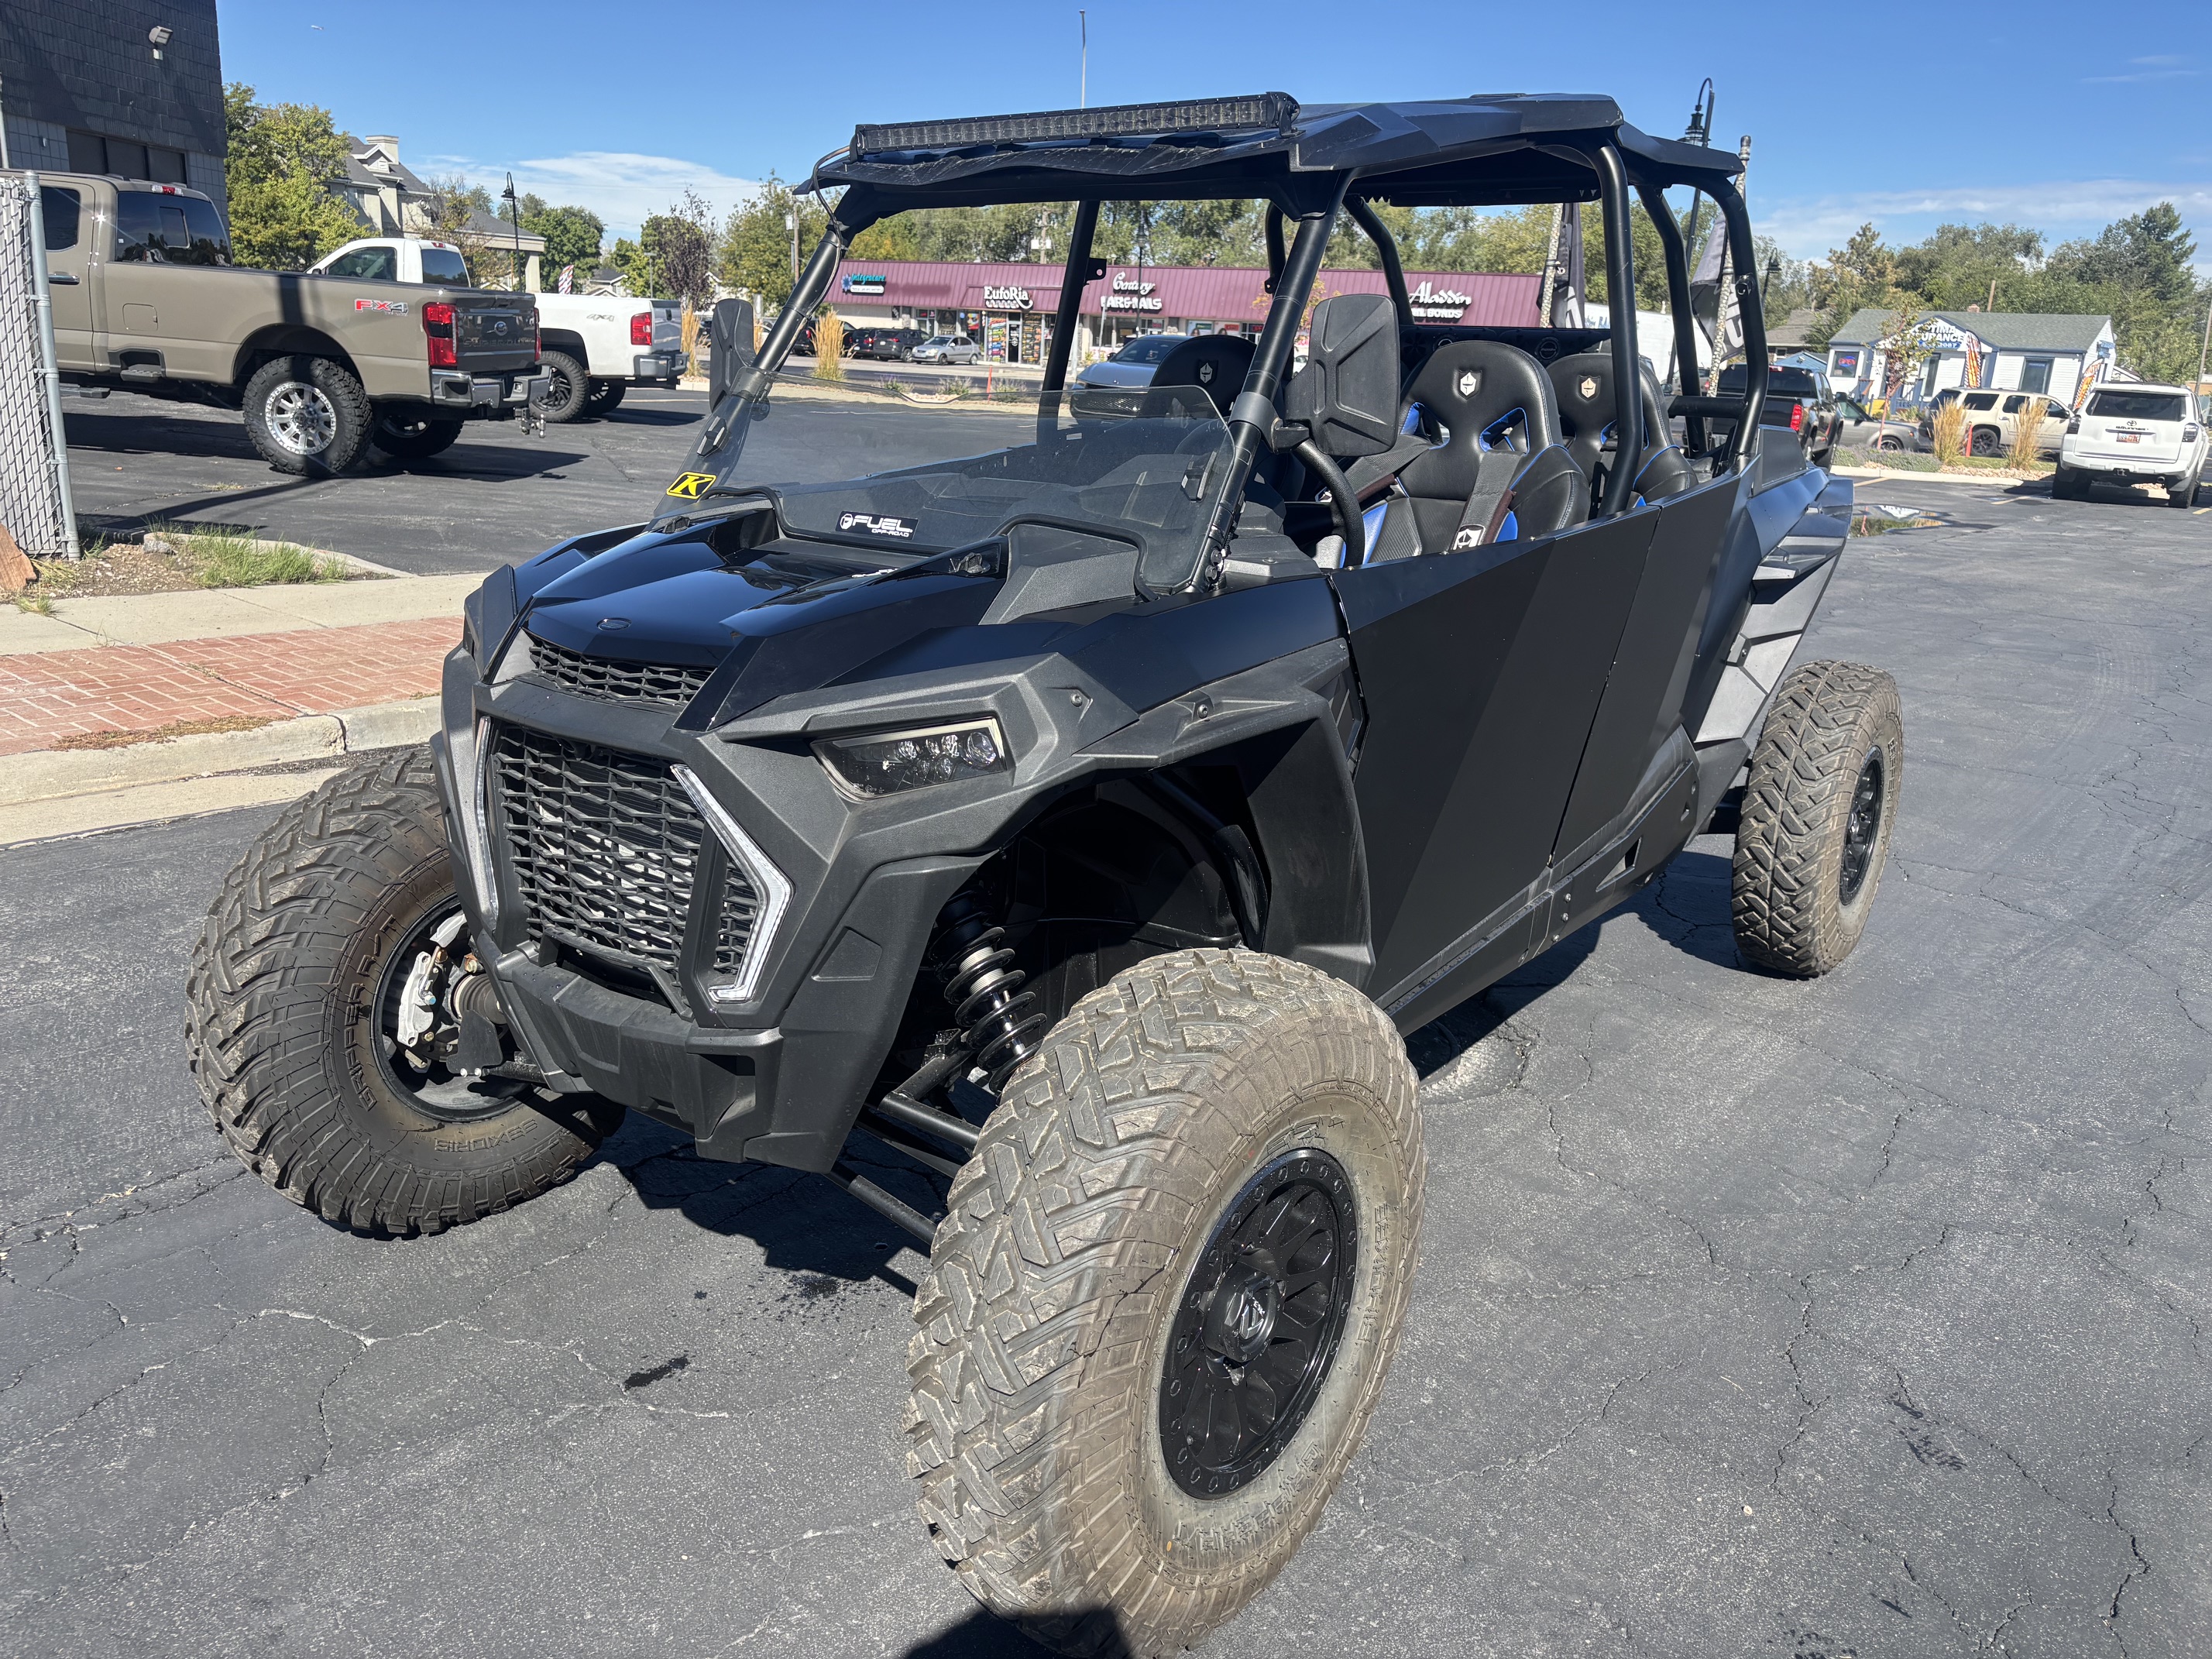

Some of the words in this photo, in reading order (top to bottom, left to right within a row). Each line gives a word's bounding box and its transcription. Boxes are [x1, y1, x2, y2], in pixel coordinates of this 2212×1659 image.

[1409, 280, 1472, 305] Aladdin
[355, 299, 408, 314] FX4
[1427, 308, 1463, 319] BONDS
[669, 475, 713, 496] K
[852, 515, 911, 533] FUEL
[871, 528, 910, 538] OFF-ROAD
[344, 983, 377, 1111] GRIPPER
